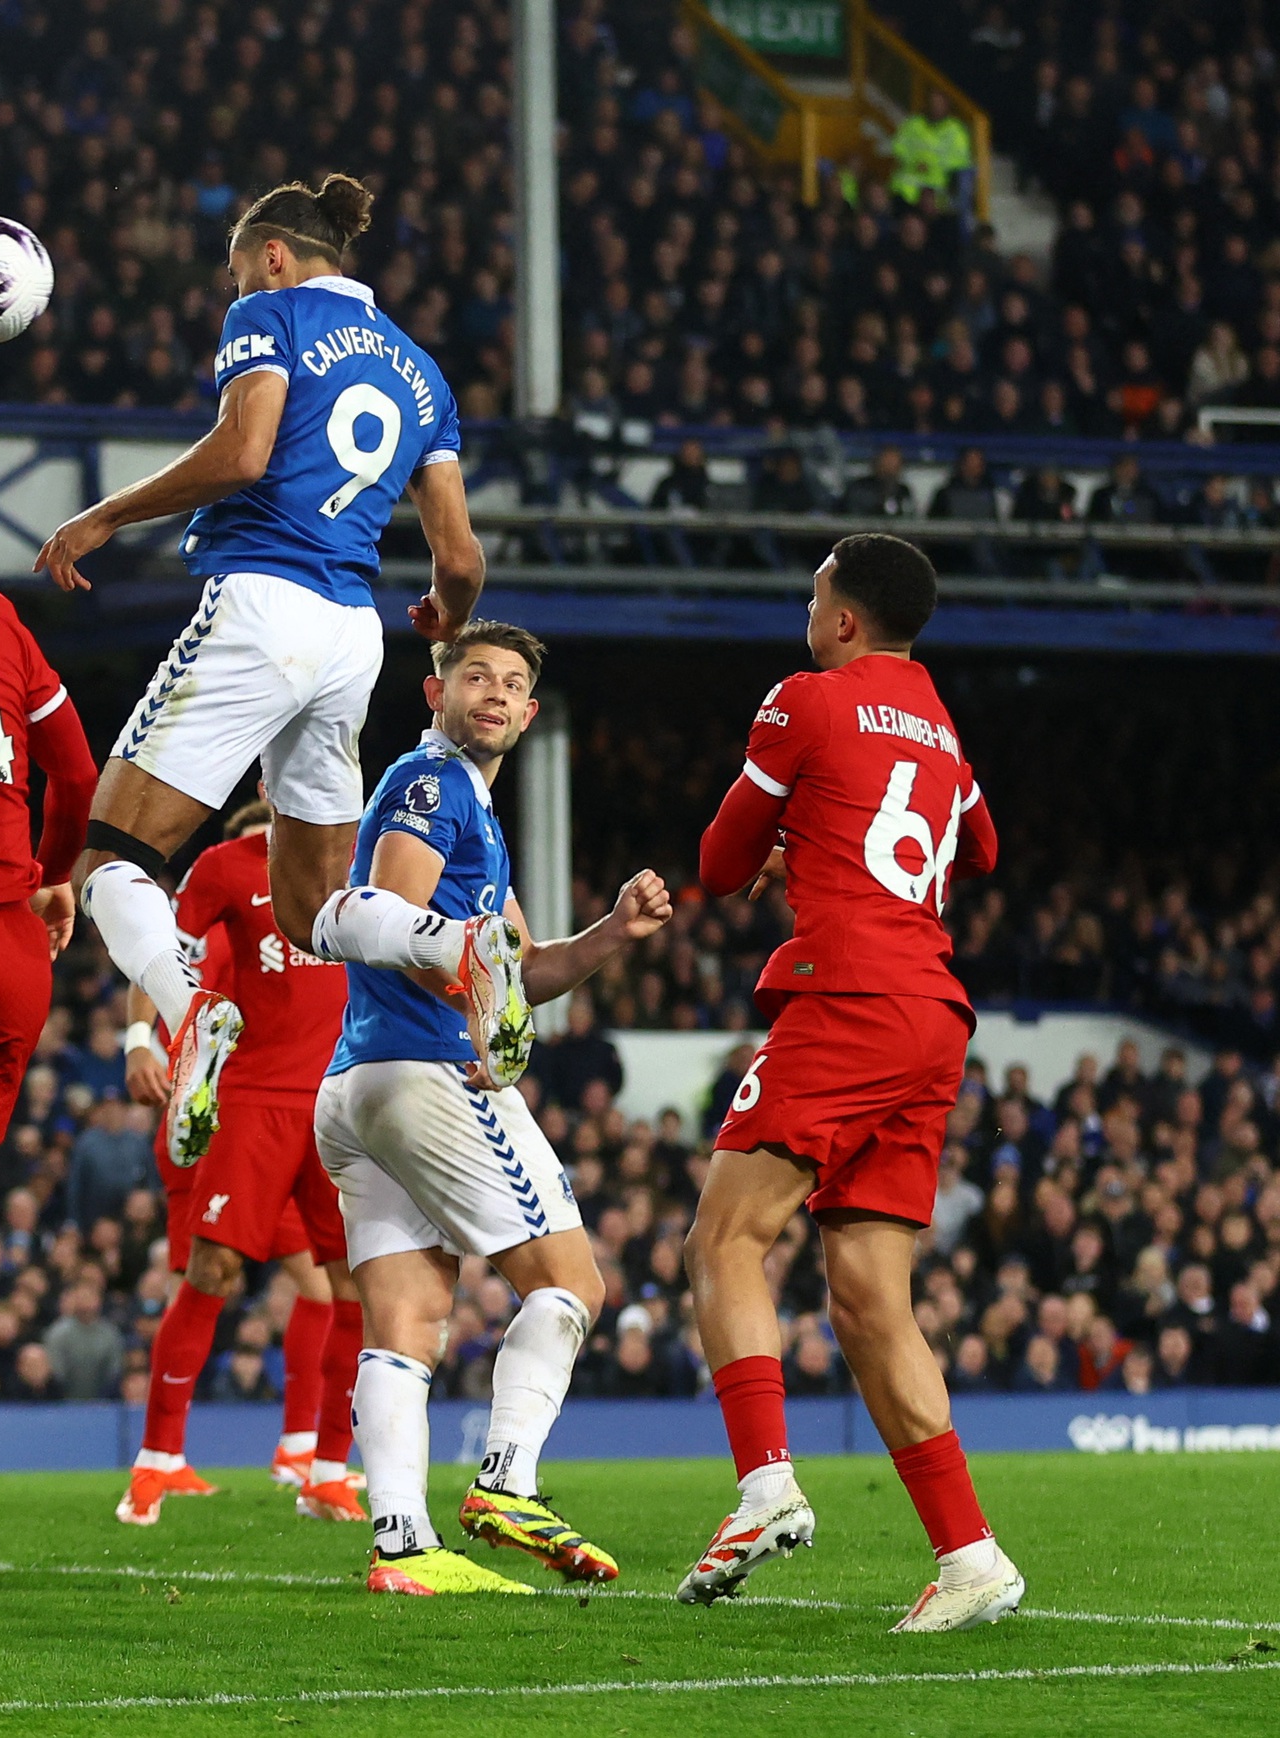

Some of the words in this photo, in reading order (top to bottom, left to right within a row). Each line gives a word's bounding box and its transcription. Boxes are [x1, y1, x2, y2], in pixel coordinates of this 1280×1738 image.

[214, 333, 276, 373] KICK
[301, 326, 435, 427] CALVERT-LEWIN
[318, 382, 402, 520] 9
[753, 706, 790, 727] edia
[731, 1054, 769, 1113] 6
